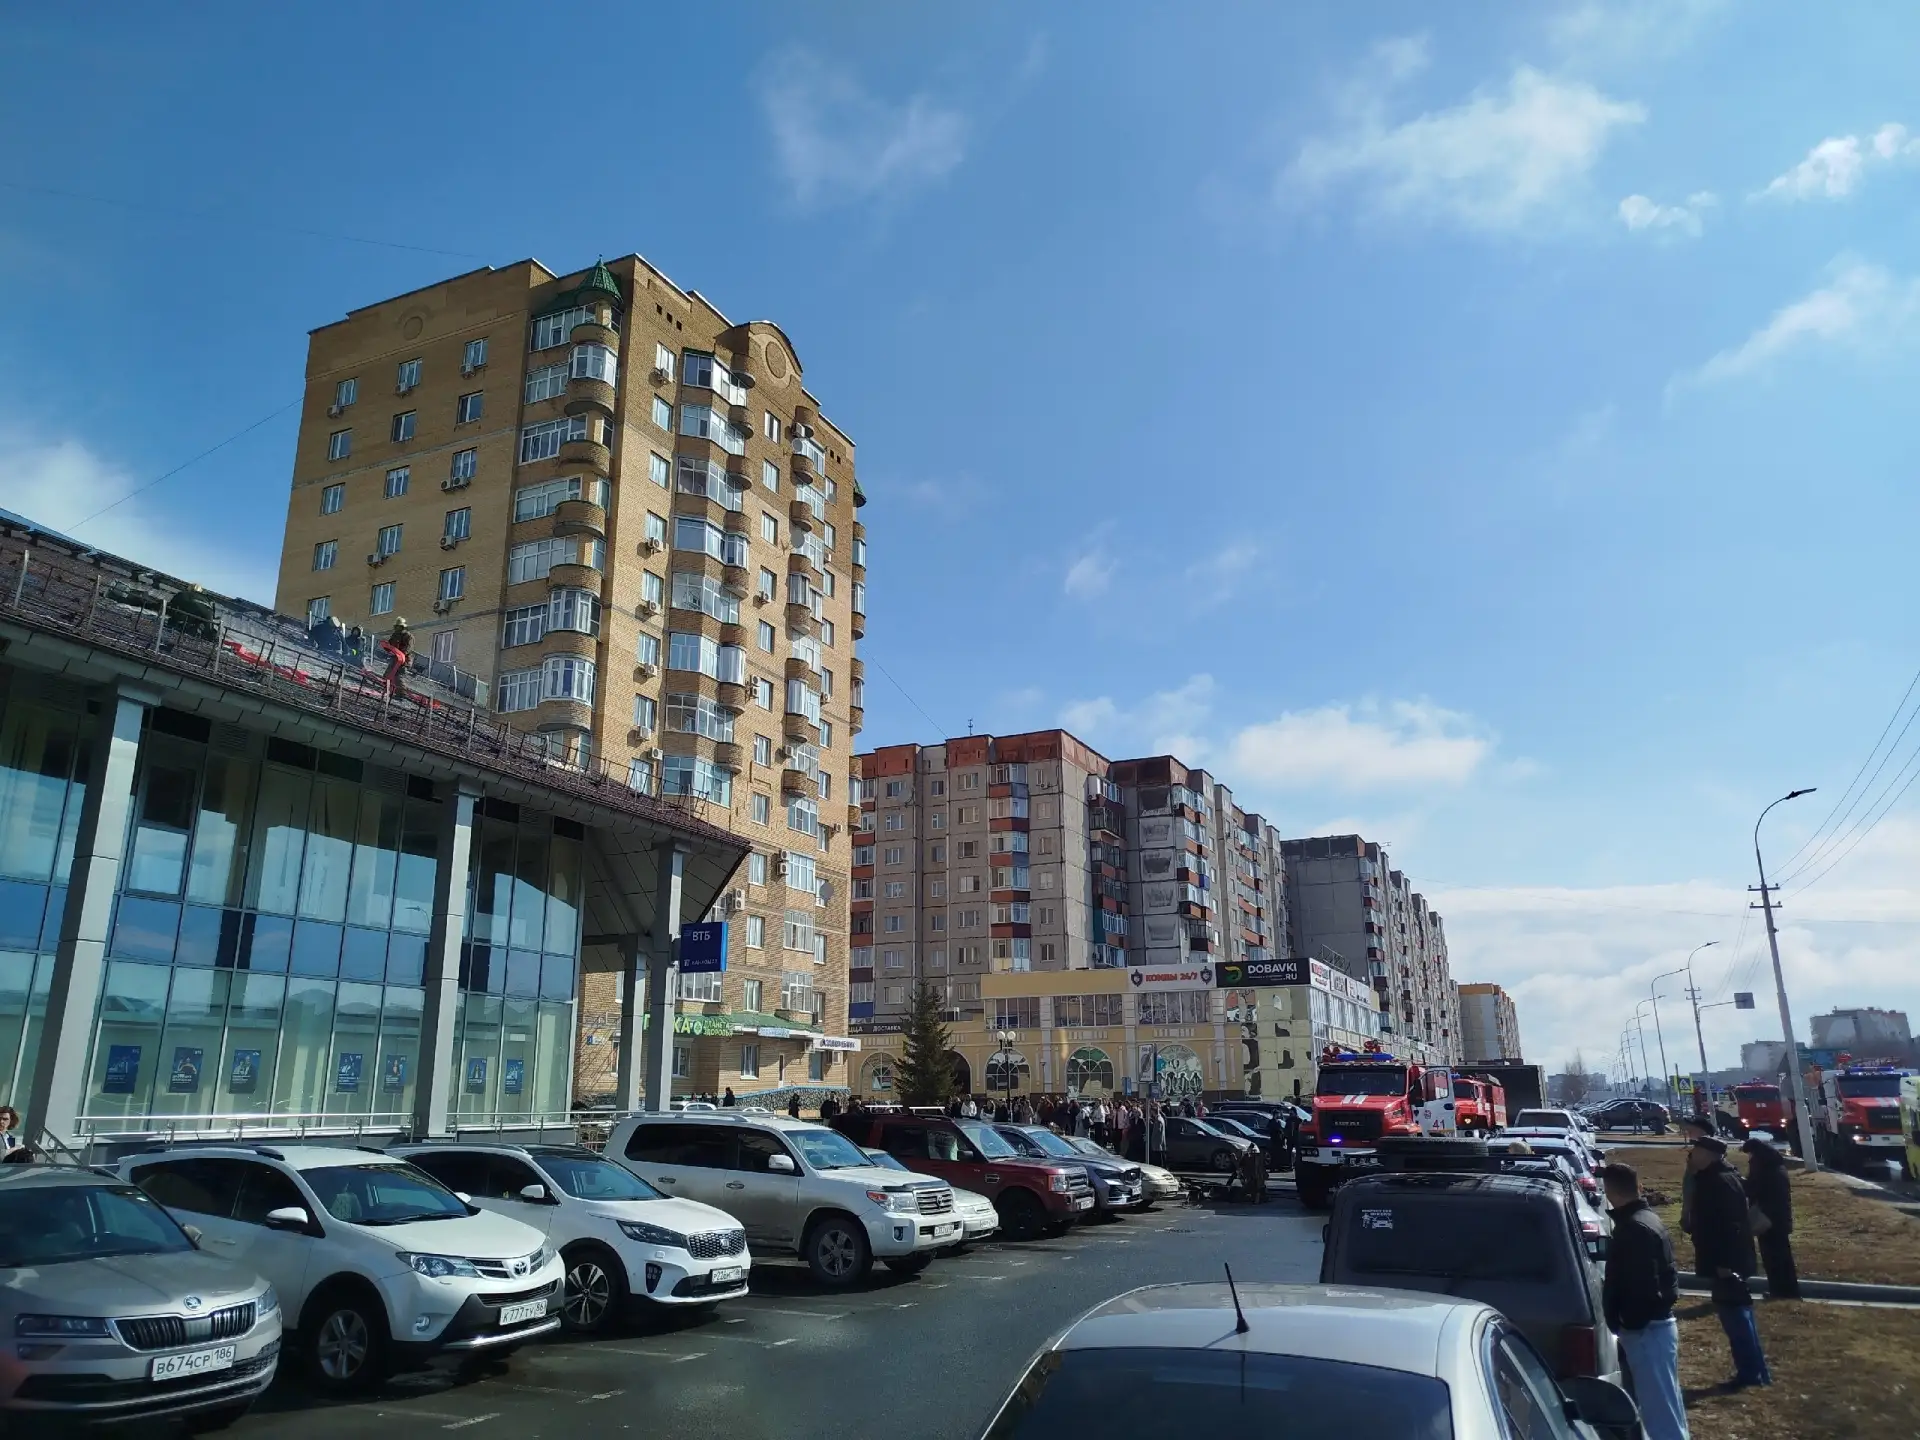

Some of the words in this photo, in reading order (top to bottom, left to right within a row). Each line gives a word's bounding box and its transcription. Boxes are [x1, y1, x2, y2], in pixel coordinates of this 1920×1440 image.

[692, 930, 711, 941] ВТБ
[1247, 962, 1298, 974] DOBAVKI
[1179, 972, 1198, 981] 24/7
[1284, 973, 1298, 981] .RU
[872, 1024, 901, 1032] ДОСТАВКА
[1432, 1119, 1444, 1129] 41
[156, 1354, 211, 1375] В674СР
[213, 1346, 232, 1360] 186
